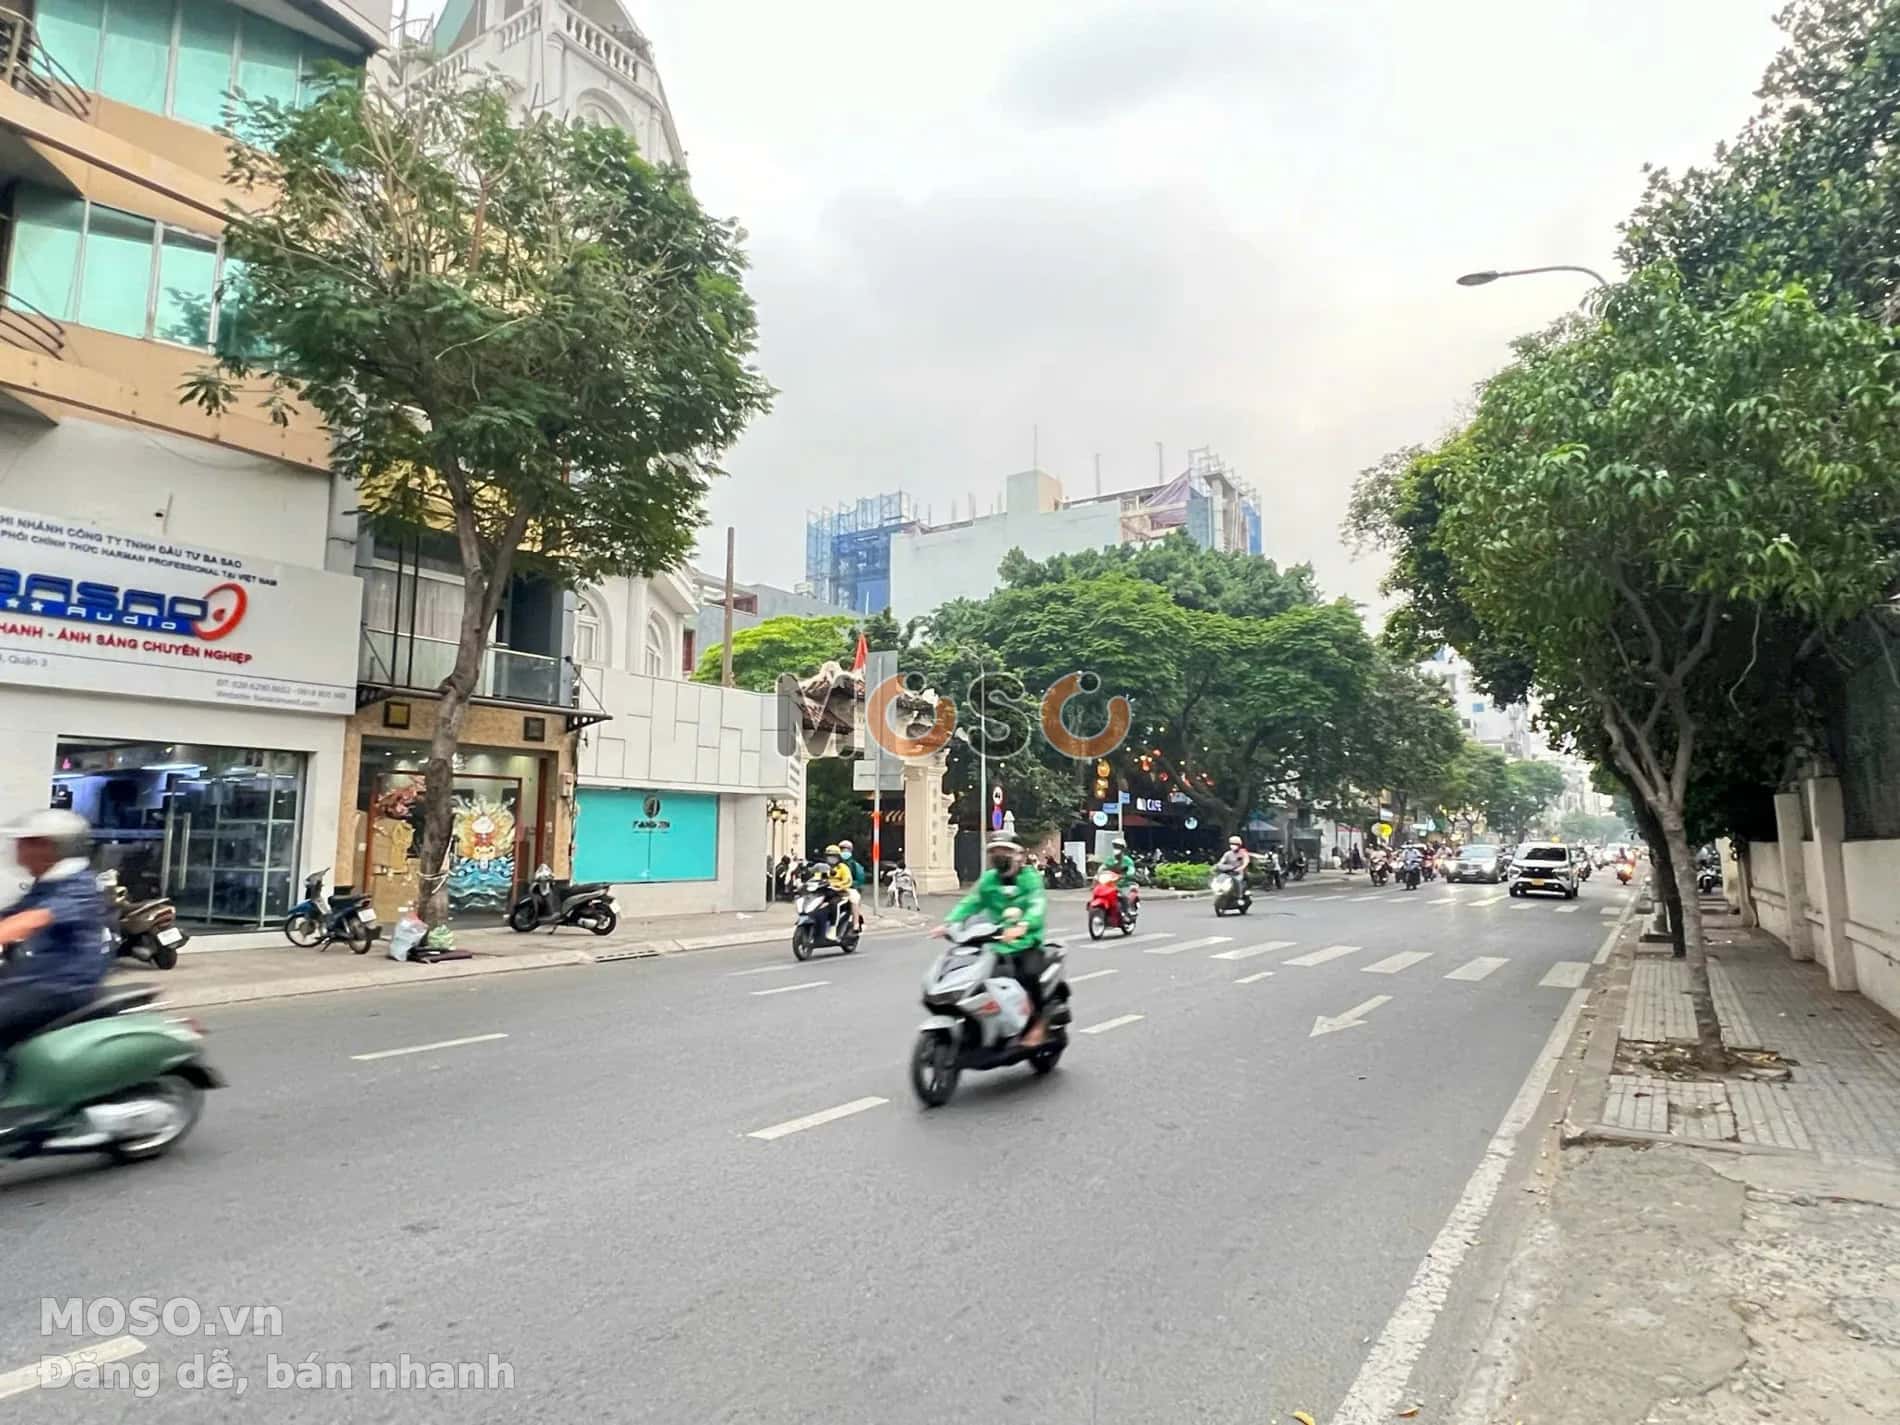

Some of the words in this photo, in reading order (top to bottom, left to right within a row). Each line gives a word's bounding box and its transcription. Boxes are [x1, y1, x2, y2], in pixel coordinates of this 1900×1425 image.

[67, 527, 102, 542] CÔNG
[107, 535, 122, 545] TY
[125, 539, 156, 551] TNHH
[148, 556, 219, 576] PROFESSIONAL
[143, 640, 200, 659] CHUYÊN
[204, 648, 253, 664] NGHIỆP
